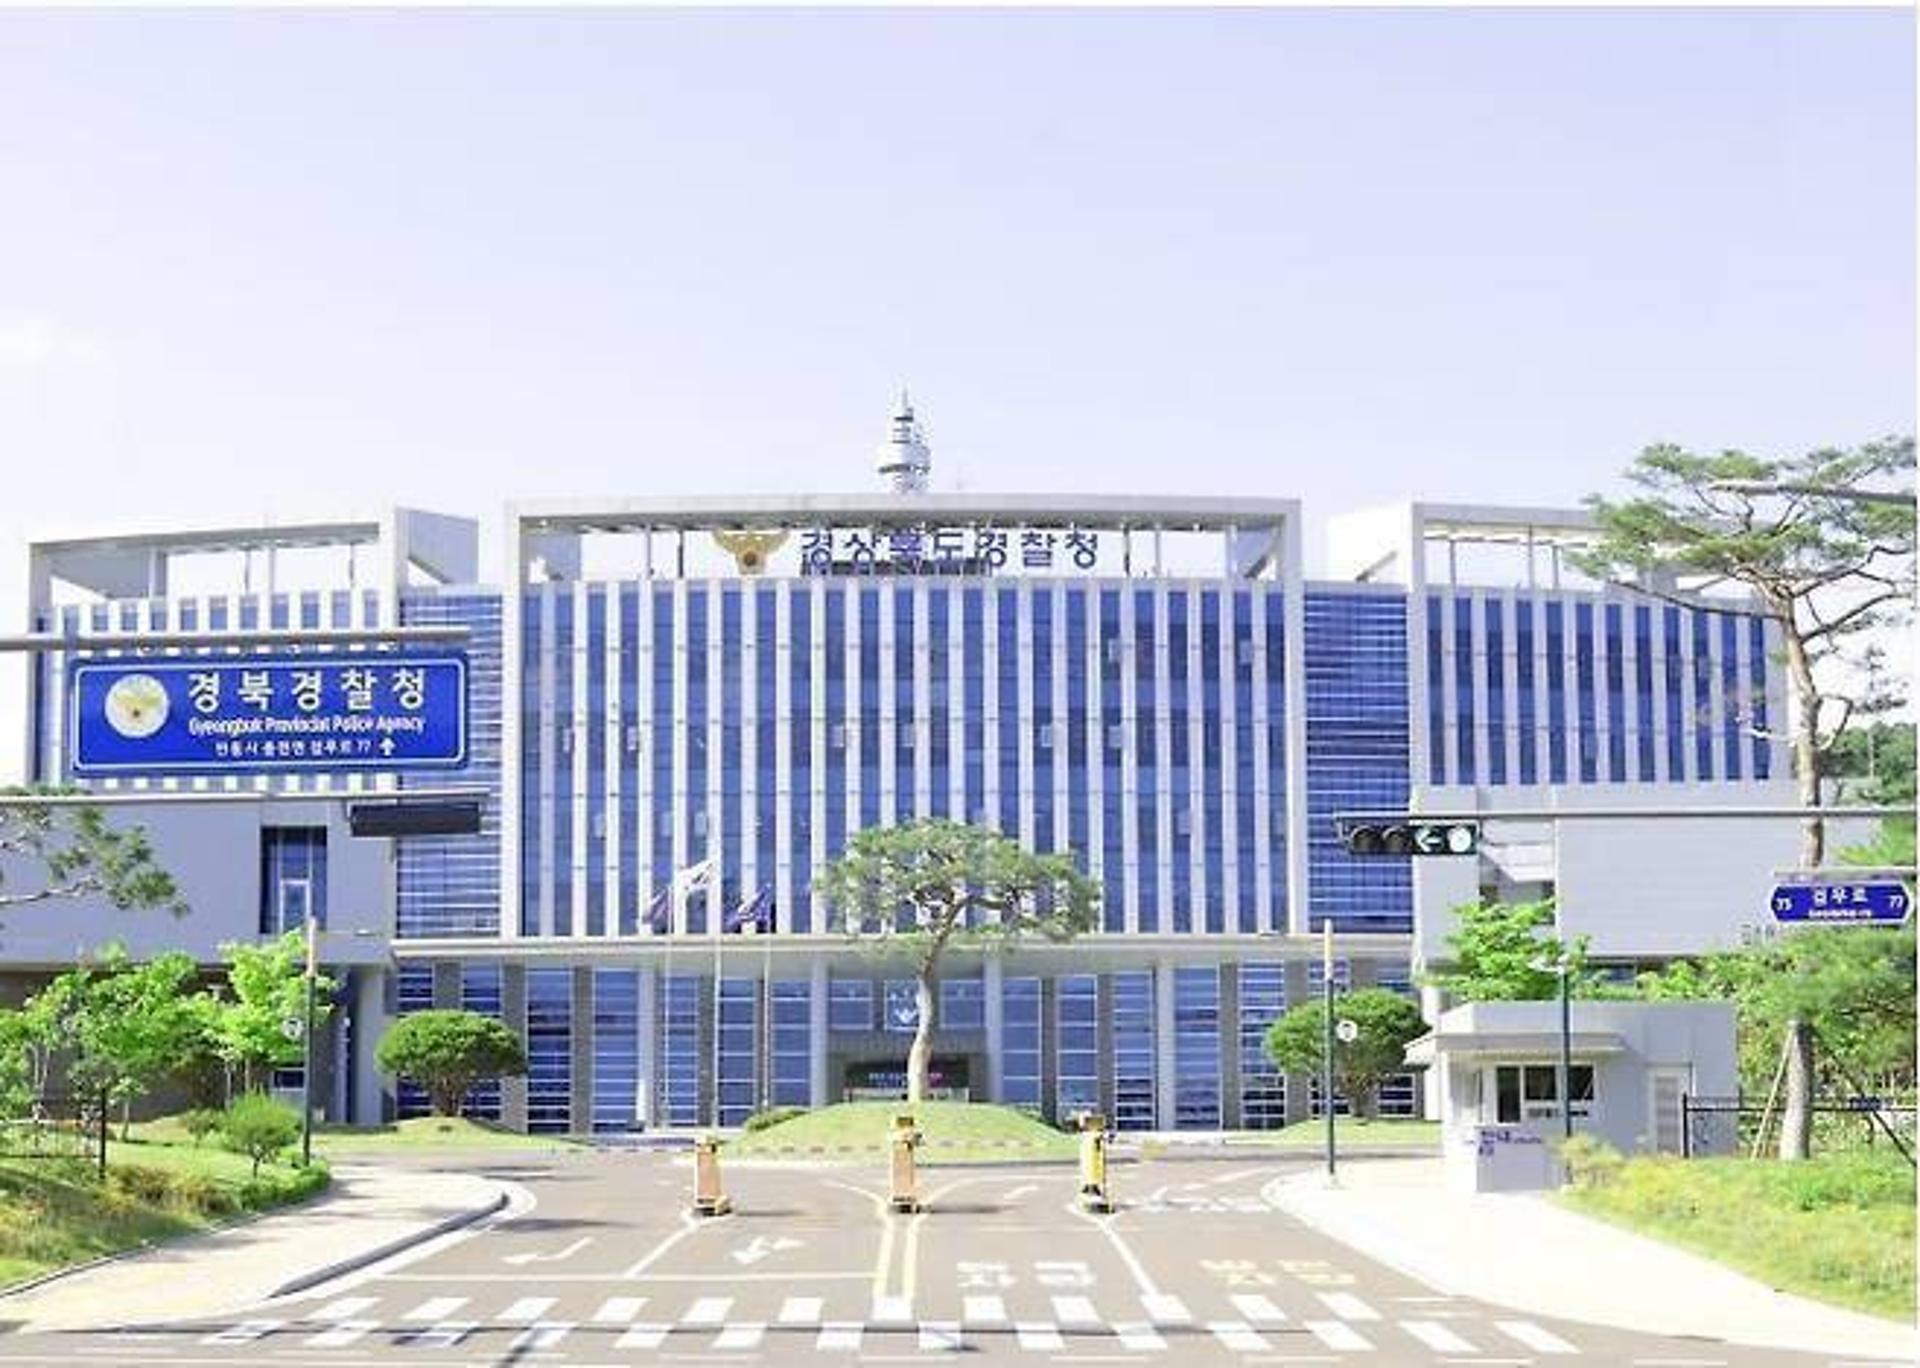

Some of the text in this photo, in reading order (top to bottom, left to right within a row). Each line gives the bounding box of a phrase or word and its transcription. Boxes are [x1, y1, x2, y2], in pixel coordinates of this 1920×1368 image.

[801, 530, 1098, 569] 경상북도경찰청
[188, 667, 425, 713] 경북경찰청
[188, 714, 426, 736] Gyeongbuk Provincial Police Agency
